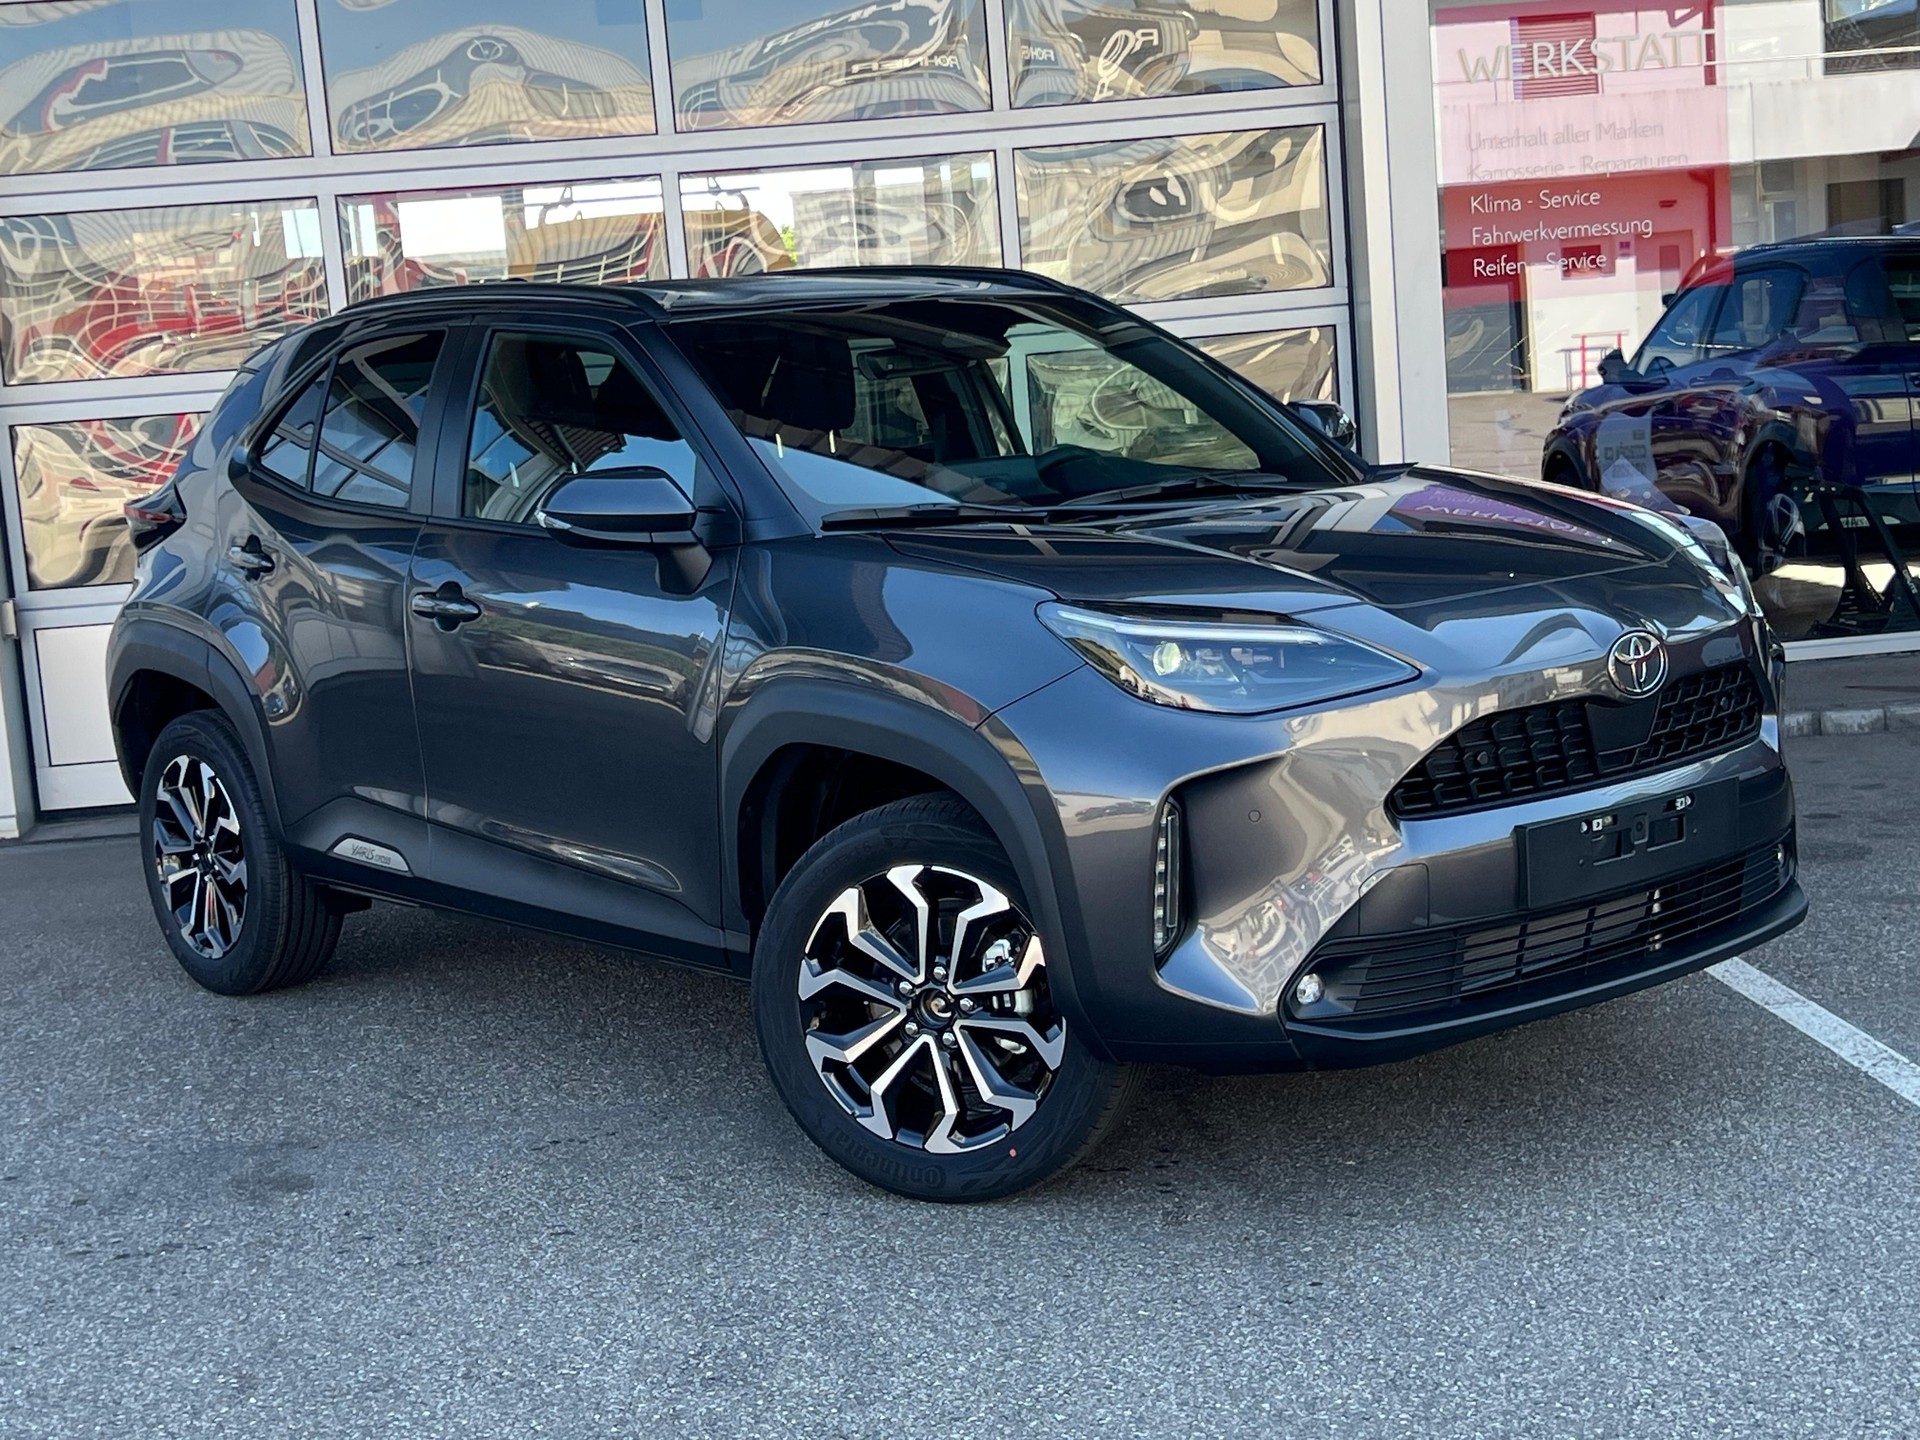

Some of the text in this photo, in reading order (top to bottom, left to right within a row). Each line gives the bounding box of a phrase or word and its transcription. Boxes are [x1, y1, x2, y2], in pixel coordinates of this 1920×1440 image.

[1458, 28, 1716, 83] WERKSTATT
[1466, 118, 1664, 152] Unterhalt aller Marken
[1470, 195, 1522, 215] Klima
[1538, 188, 1601, 210] Service
[1471, 218, 1654, 247] Fahrwerkvermessung
[1473, 251, 1608, 279] Reifen Service
